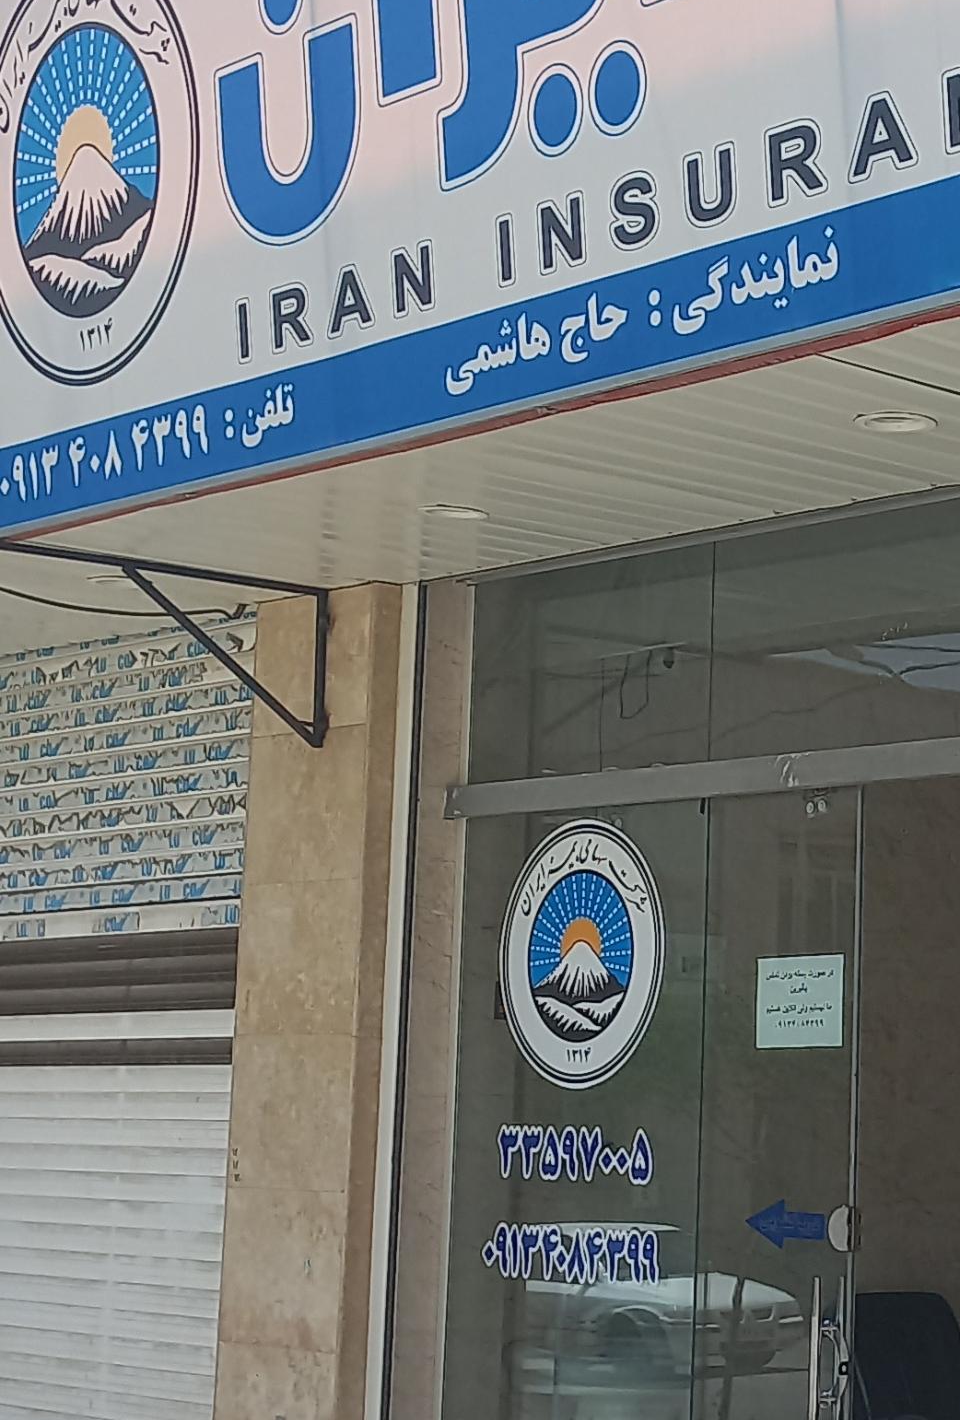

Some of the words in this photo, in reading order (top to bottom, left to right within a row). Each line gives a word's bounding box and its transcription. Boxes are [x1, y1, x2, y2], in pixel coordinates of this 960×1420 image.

[235, 239, 436, 364] IRAN
[560, 291, 630, 364] حاج
[79, 317, 114, 351] ۱۳۱۴
[444, 312, 552, 397] هاشمی
[565, 1045, 593, 1064] ۱۳۱۴
[497, 1123, 654, 1186] ۳۳۵۹۷۰۰۵
[481, 1221, 660, 1285] ۰۹۱۳۴۰۸۴۳۹۹
